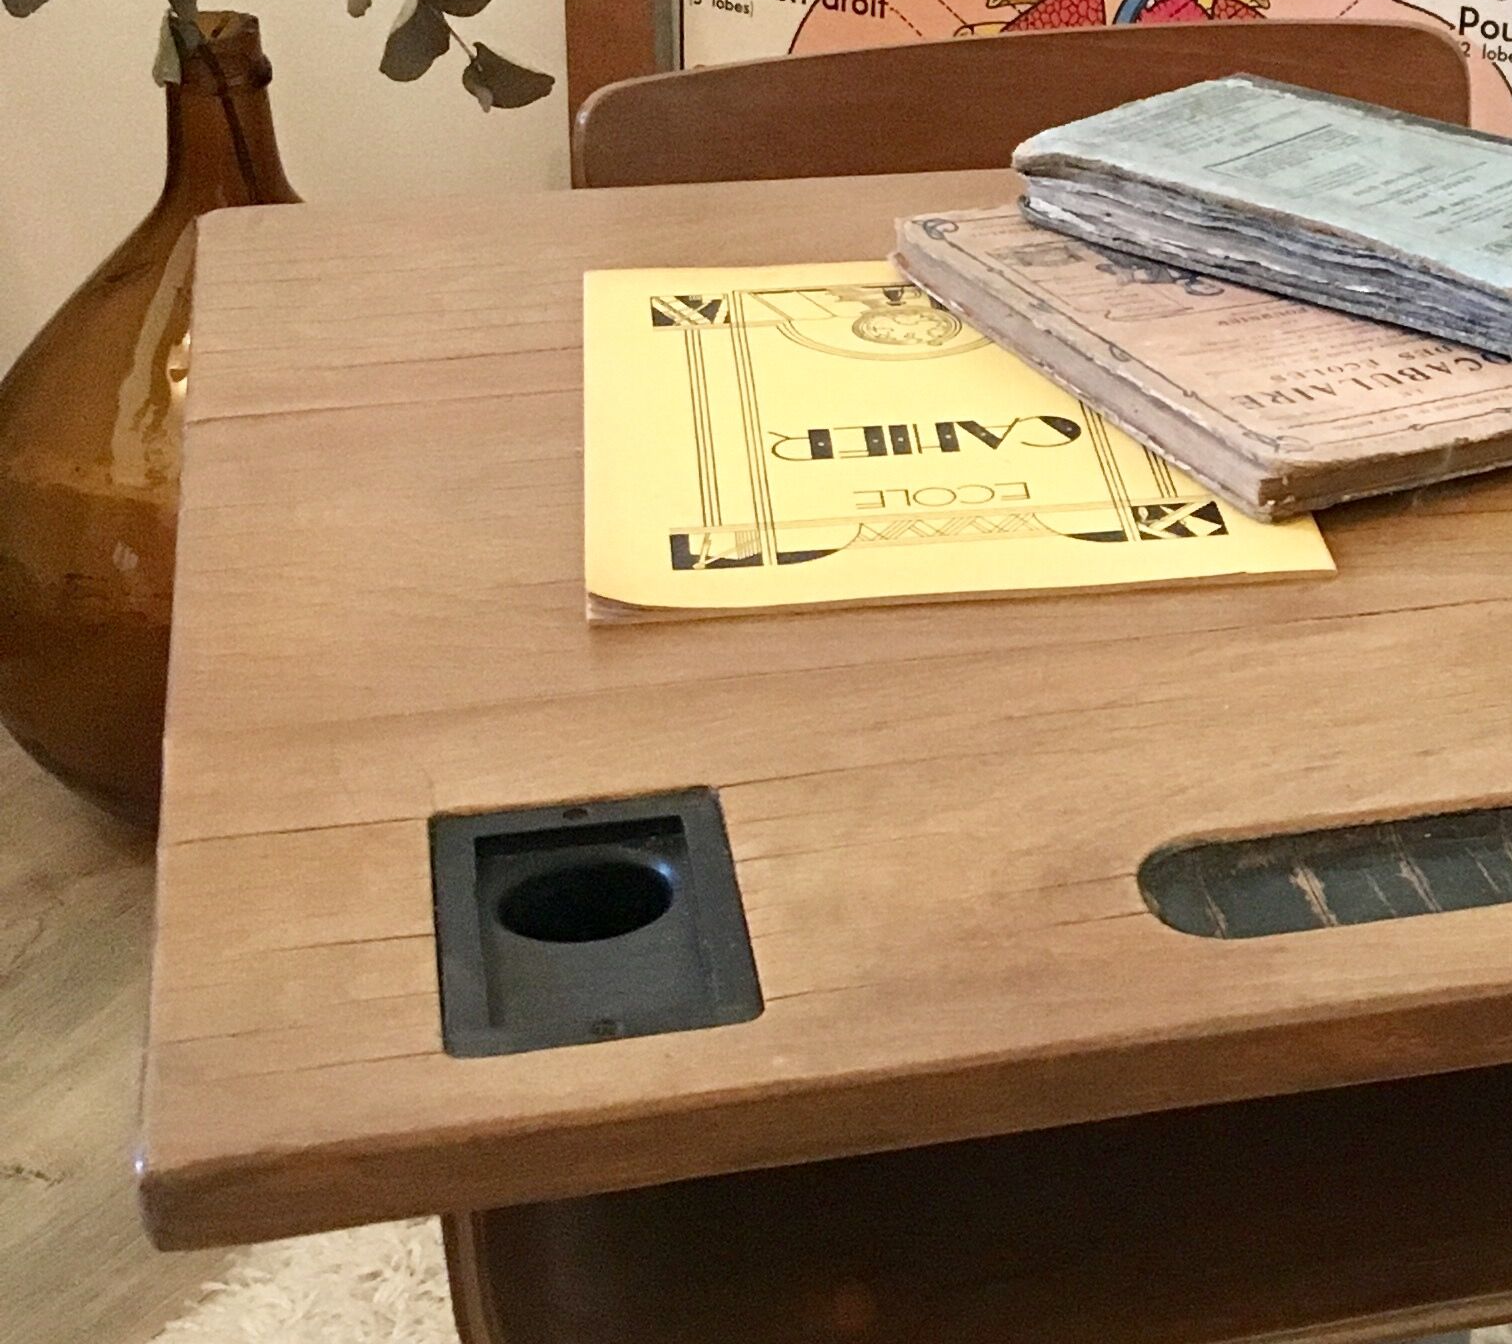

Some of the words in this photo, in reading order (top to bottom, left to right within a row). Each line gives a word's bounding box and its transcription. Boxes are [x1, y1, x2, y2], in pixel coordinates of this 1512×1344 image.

[1231, 351, 1512, 410] OCABULAIRE
[767, 414, 1082, 462] CAHIER
[852, 481, 1030, 511] ECOLE
